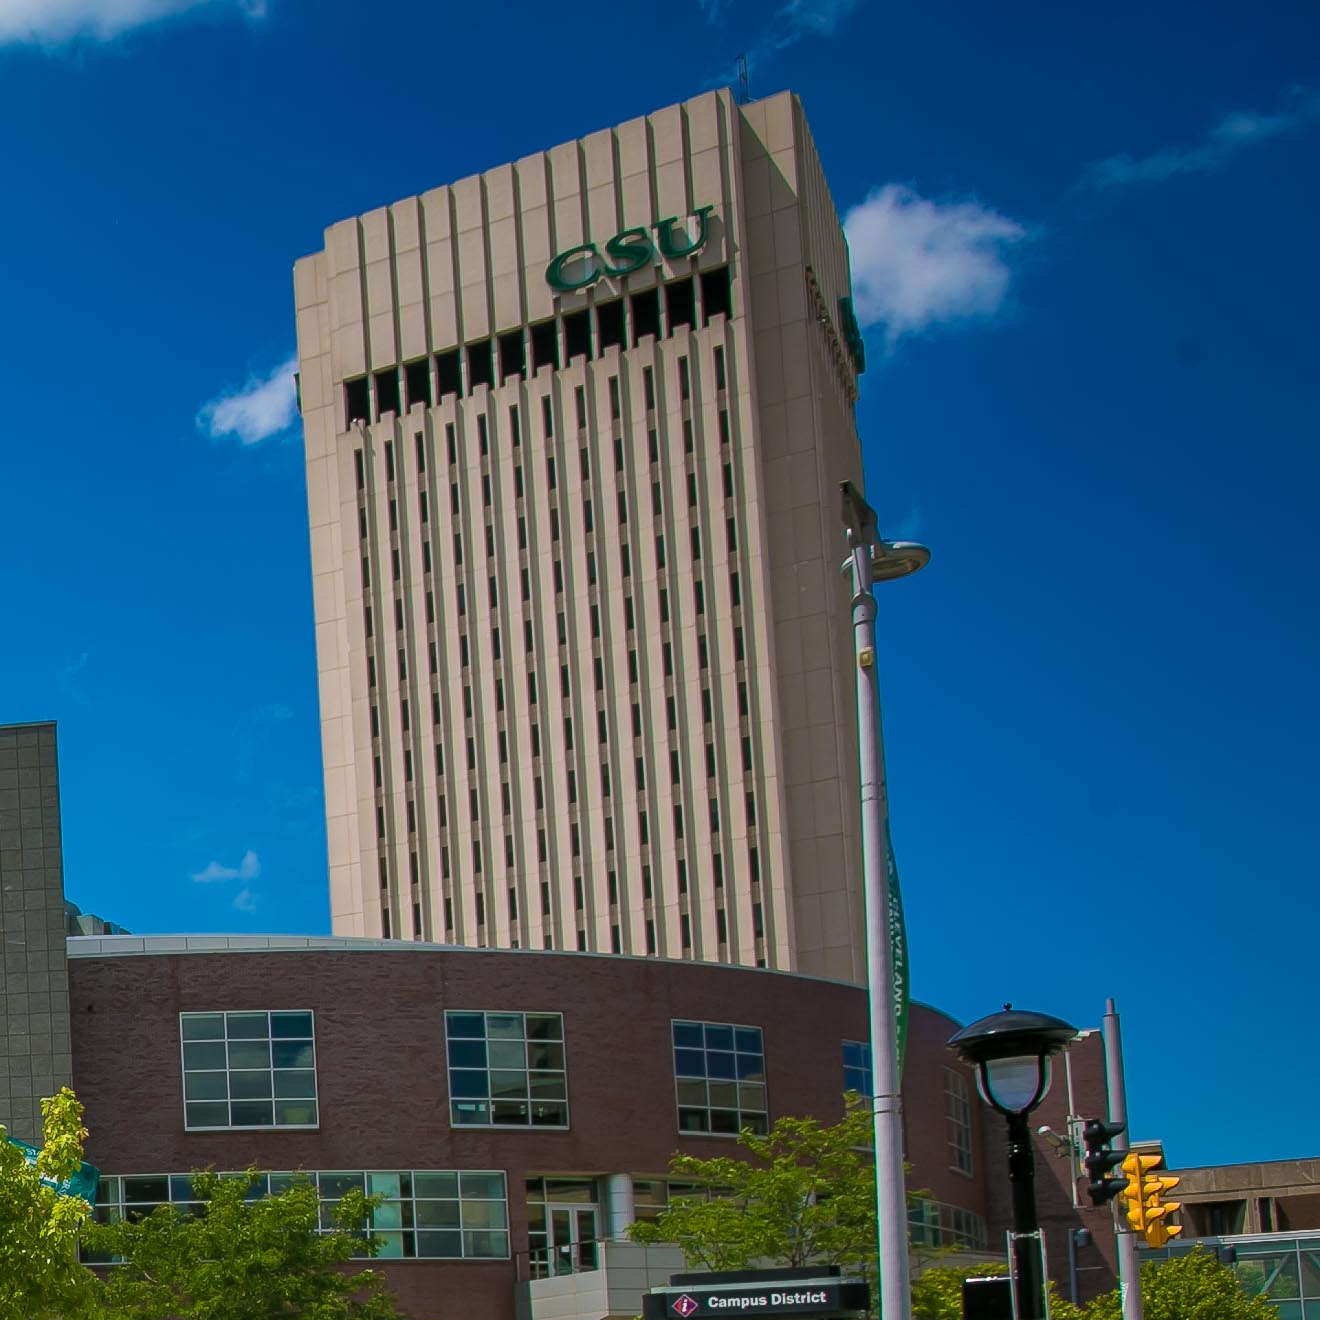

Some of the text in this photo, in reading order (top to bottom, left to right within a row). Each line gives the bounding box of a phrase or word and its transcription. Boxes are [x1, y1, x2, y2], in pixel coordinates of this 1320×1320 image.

[545, 204, 714, 292] CSU
[708, 1291, 827, 1309] Campus District
